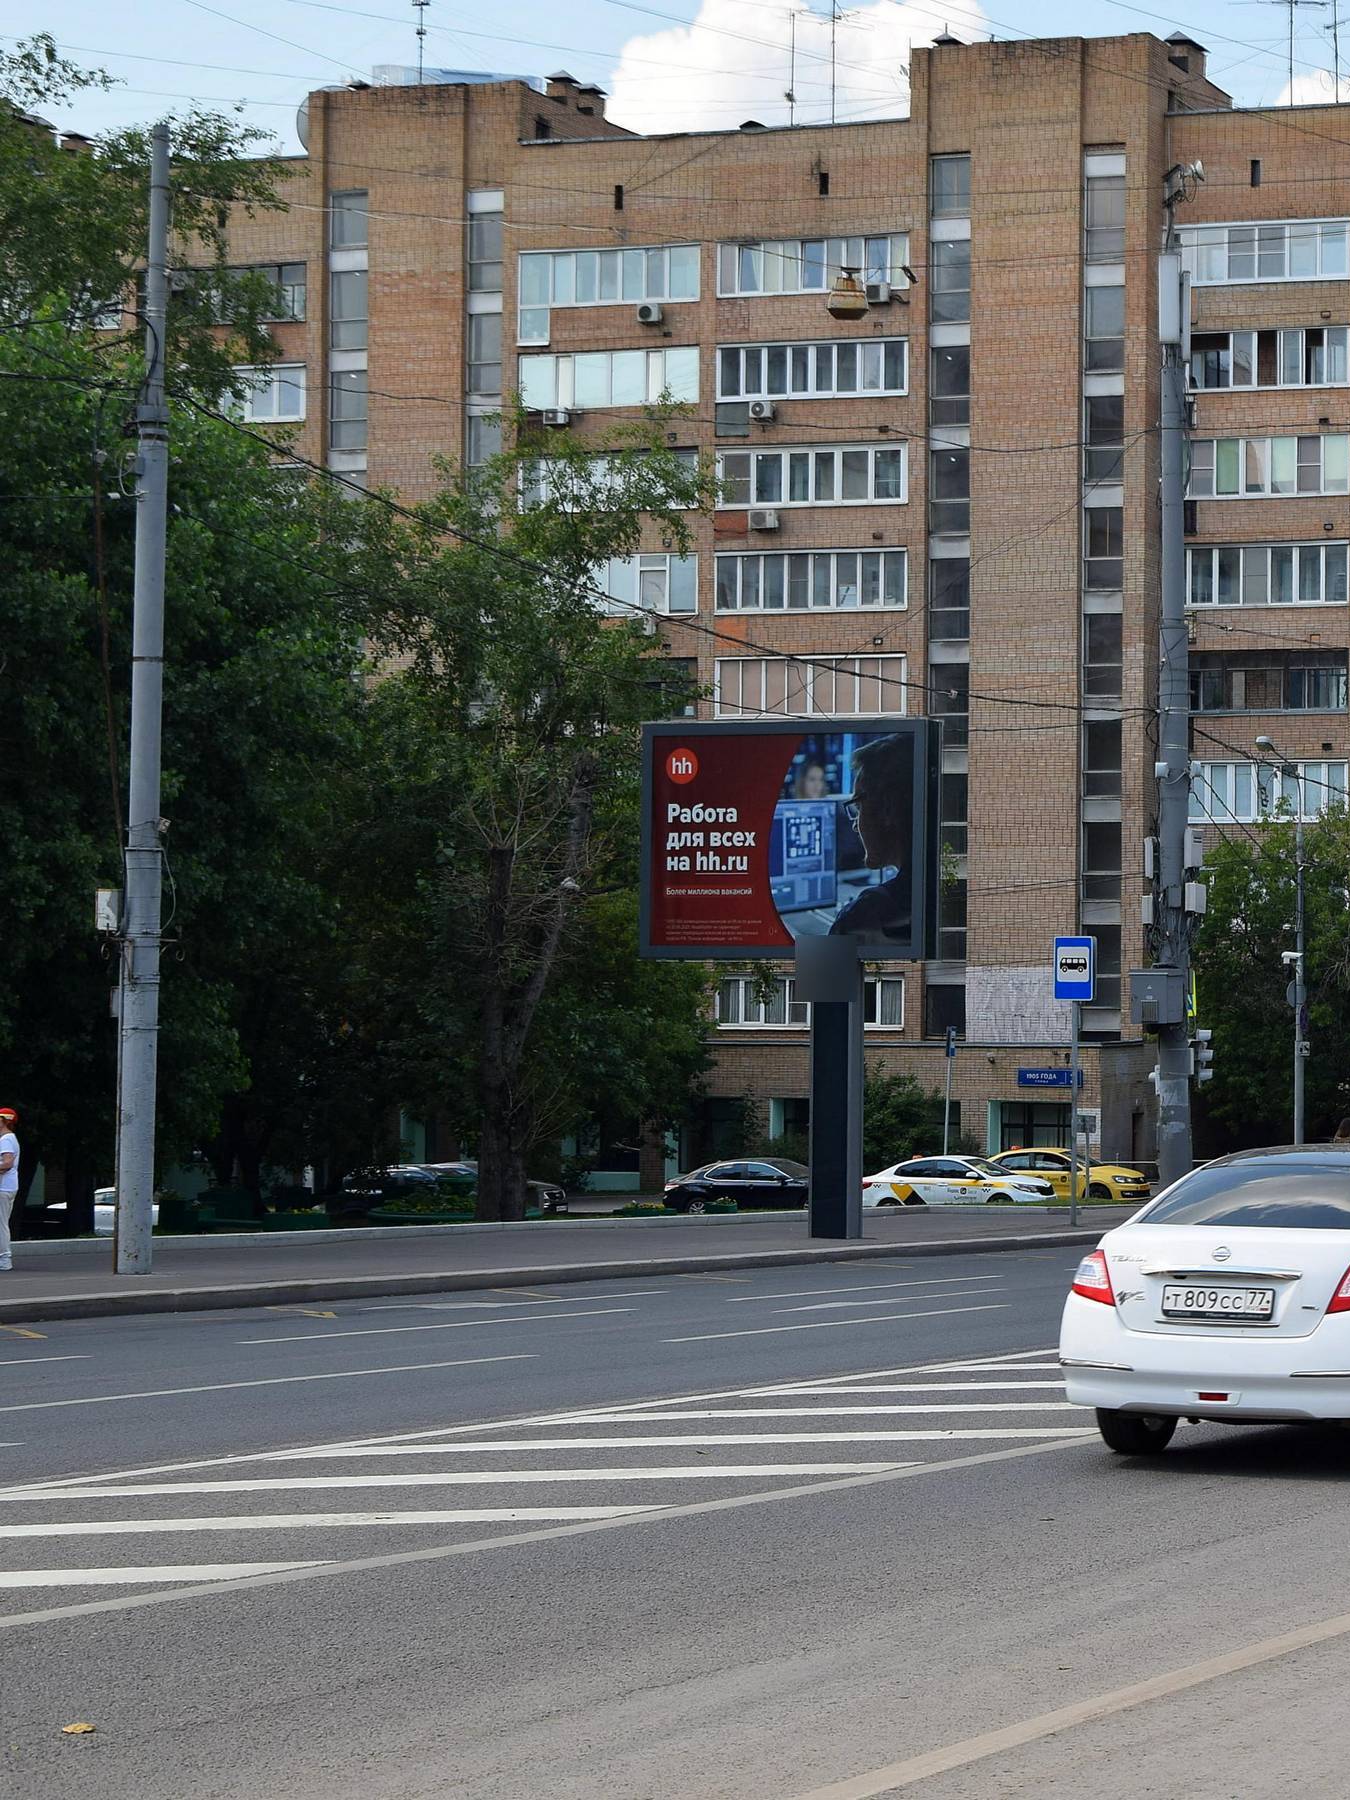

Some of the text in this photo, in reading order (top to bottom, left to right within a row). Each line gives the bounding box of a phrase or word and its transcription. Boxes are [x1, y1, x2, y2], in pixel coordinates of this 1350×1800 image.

[672, 757, 692, 774] hh
[667, 803, 738, 823] Работа
[666, 831, 756, 850] для всех
[666, 851, 748, 871] на hh.ru
[666, 887, 753, 896] Более миллиона вакансий
[1248, 1291, 1267, 1306] 77
